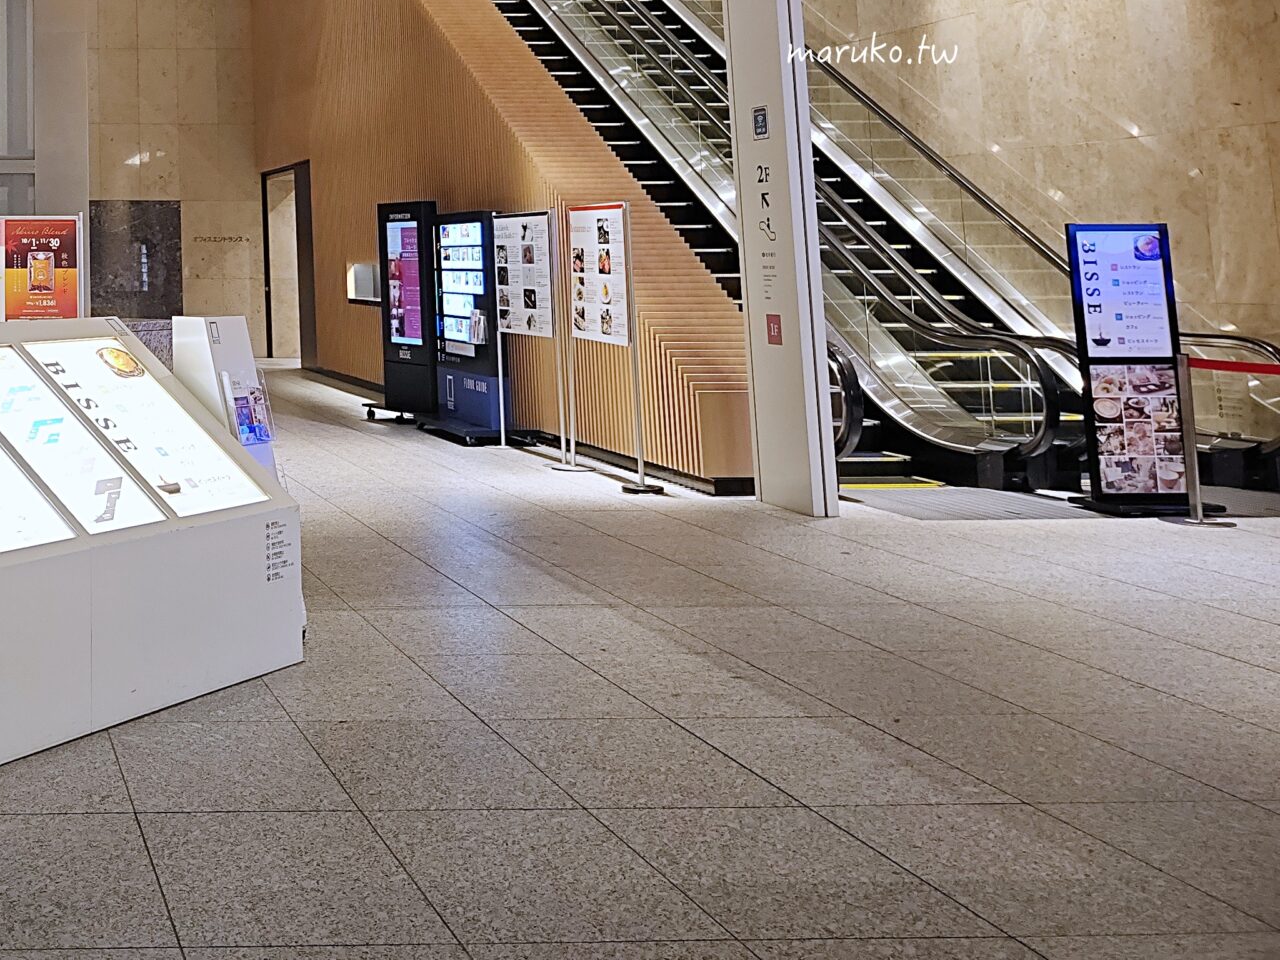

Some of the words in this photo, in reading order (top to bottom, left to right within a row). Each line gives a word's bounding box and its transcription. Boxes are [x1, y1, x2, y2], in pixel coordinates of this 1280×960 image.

[757, 165, 770, 183] 2F
[1081, 241, 1103, 315] BISSE
[42, 360, 138, 453] BISSE
